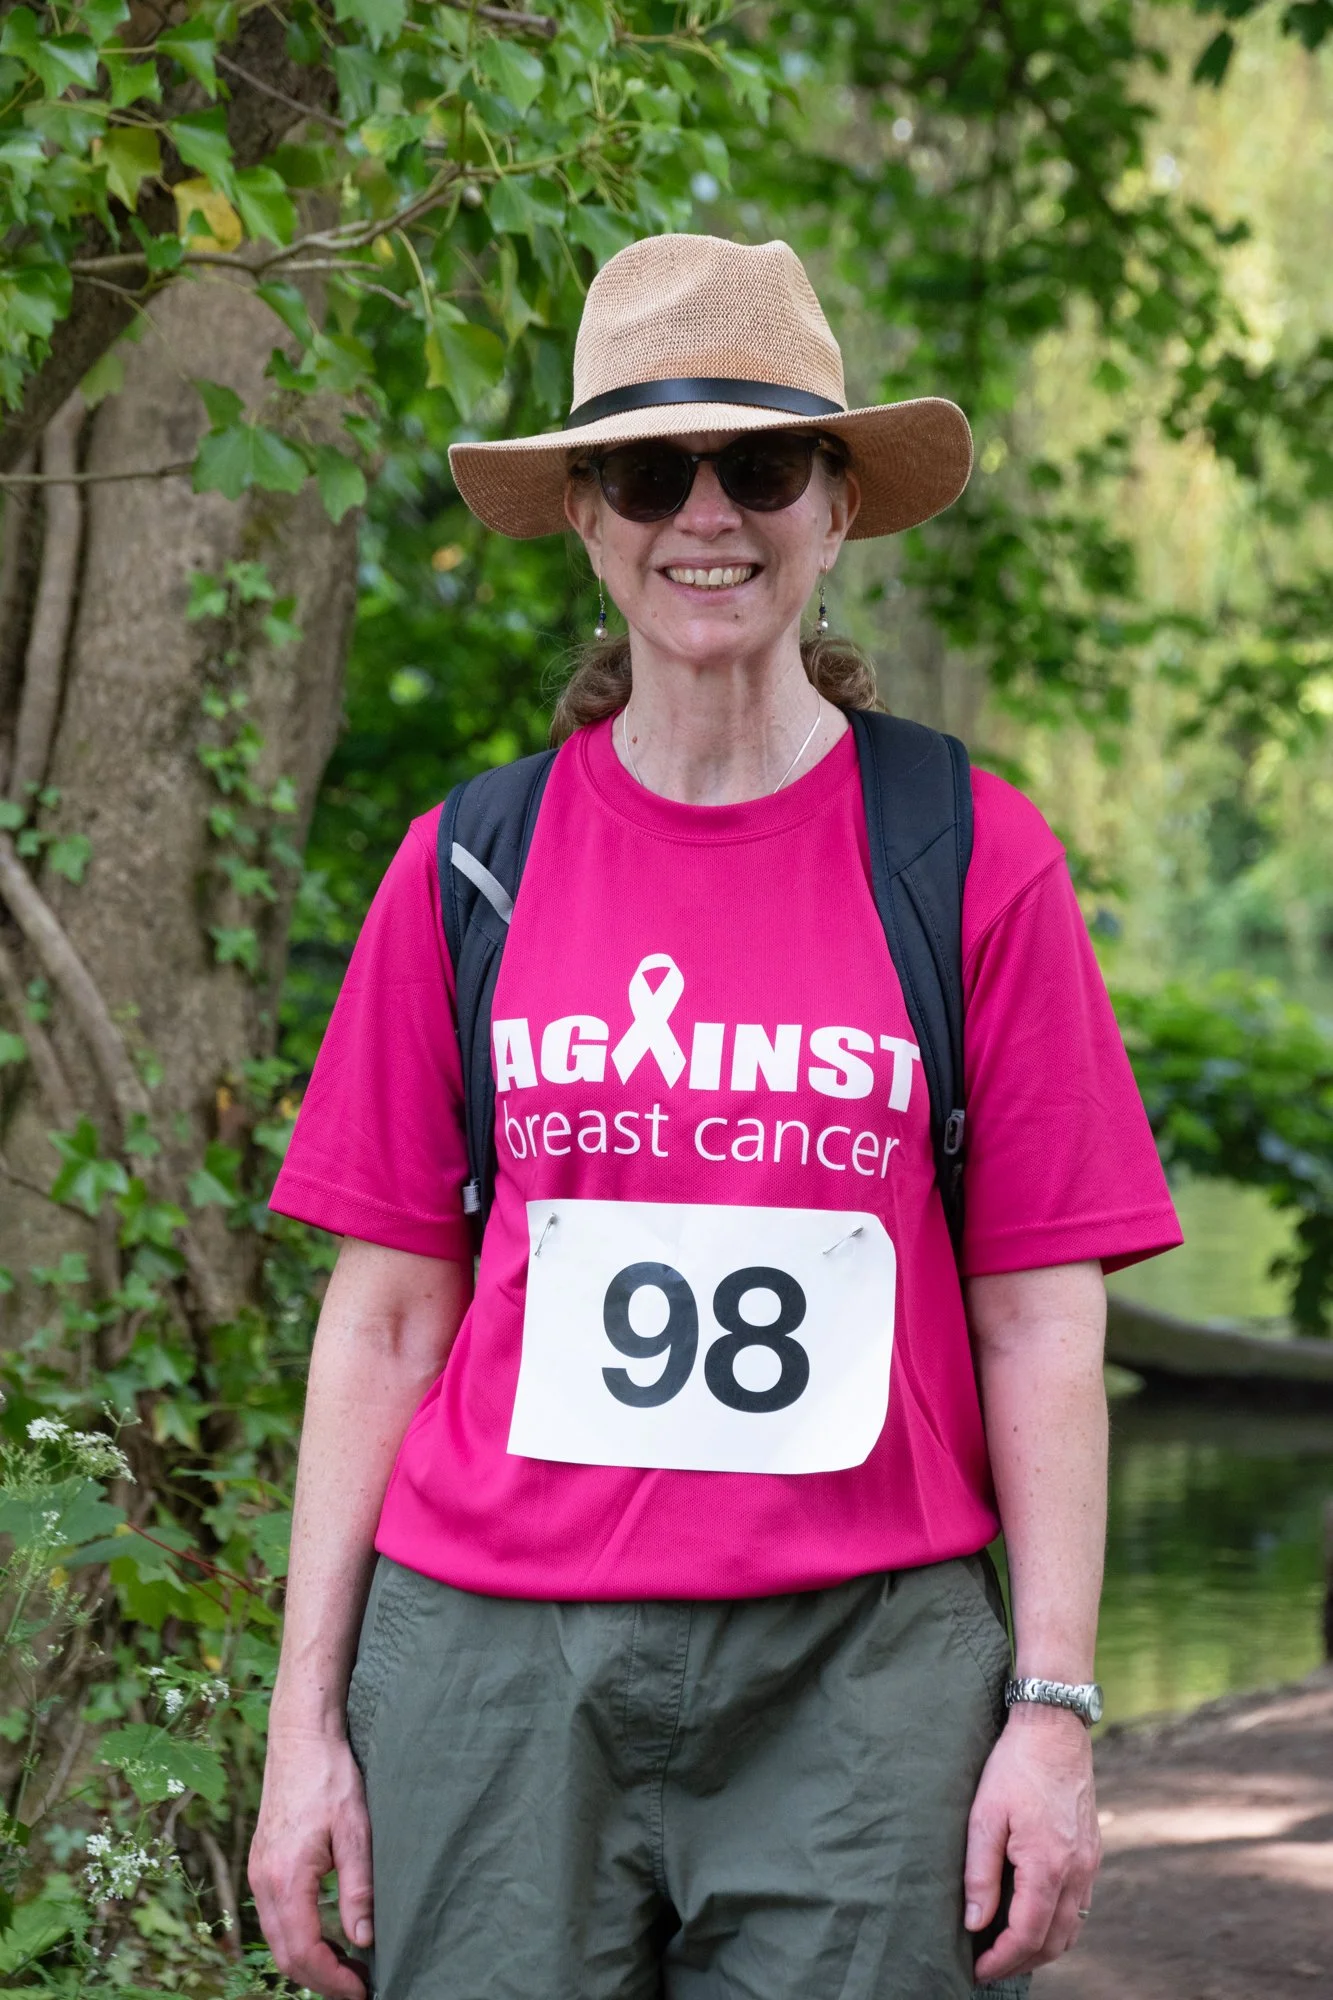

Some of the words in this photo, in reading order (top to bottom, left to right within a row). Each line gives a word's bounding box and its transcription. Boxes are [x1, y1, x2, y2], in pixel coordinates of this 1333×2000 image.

[492, 953, 921, 1112] AGAINST
[503, 1101, 669, 1160] breast
[694, 1116, 900, 1178] cancer
[601, 1261, 810, 1413] 98
